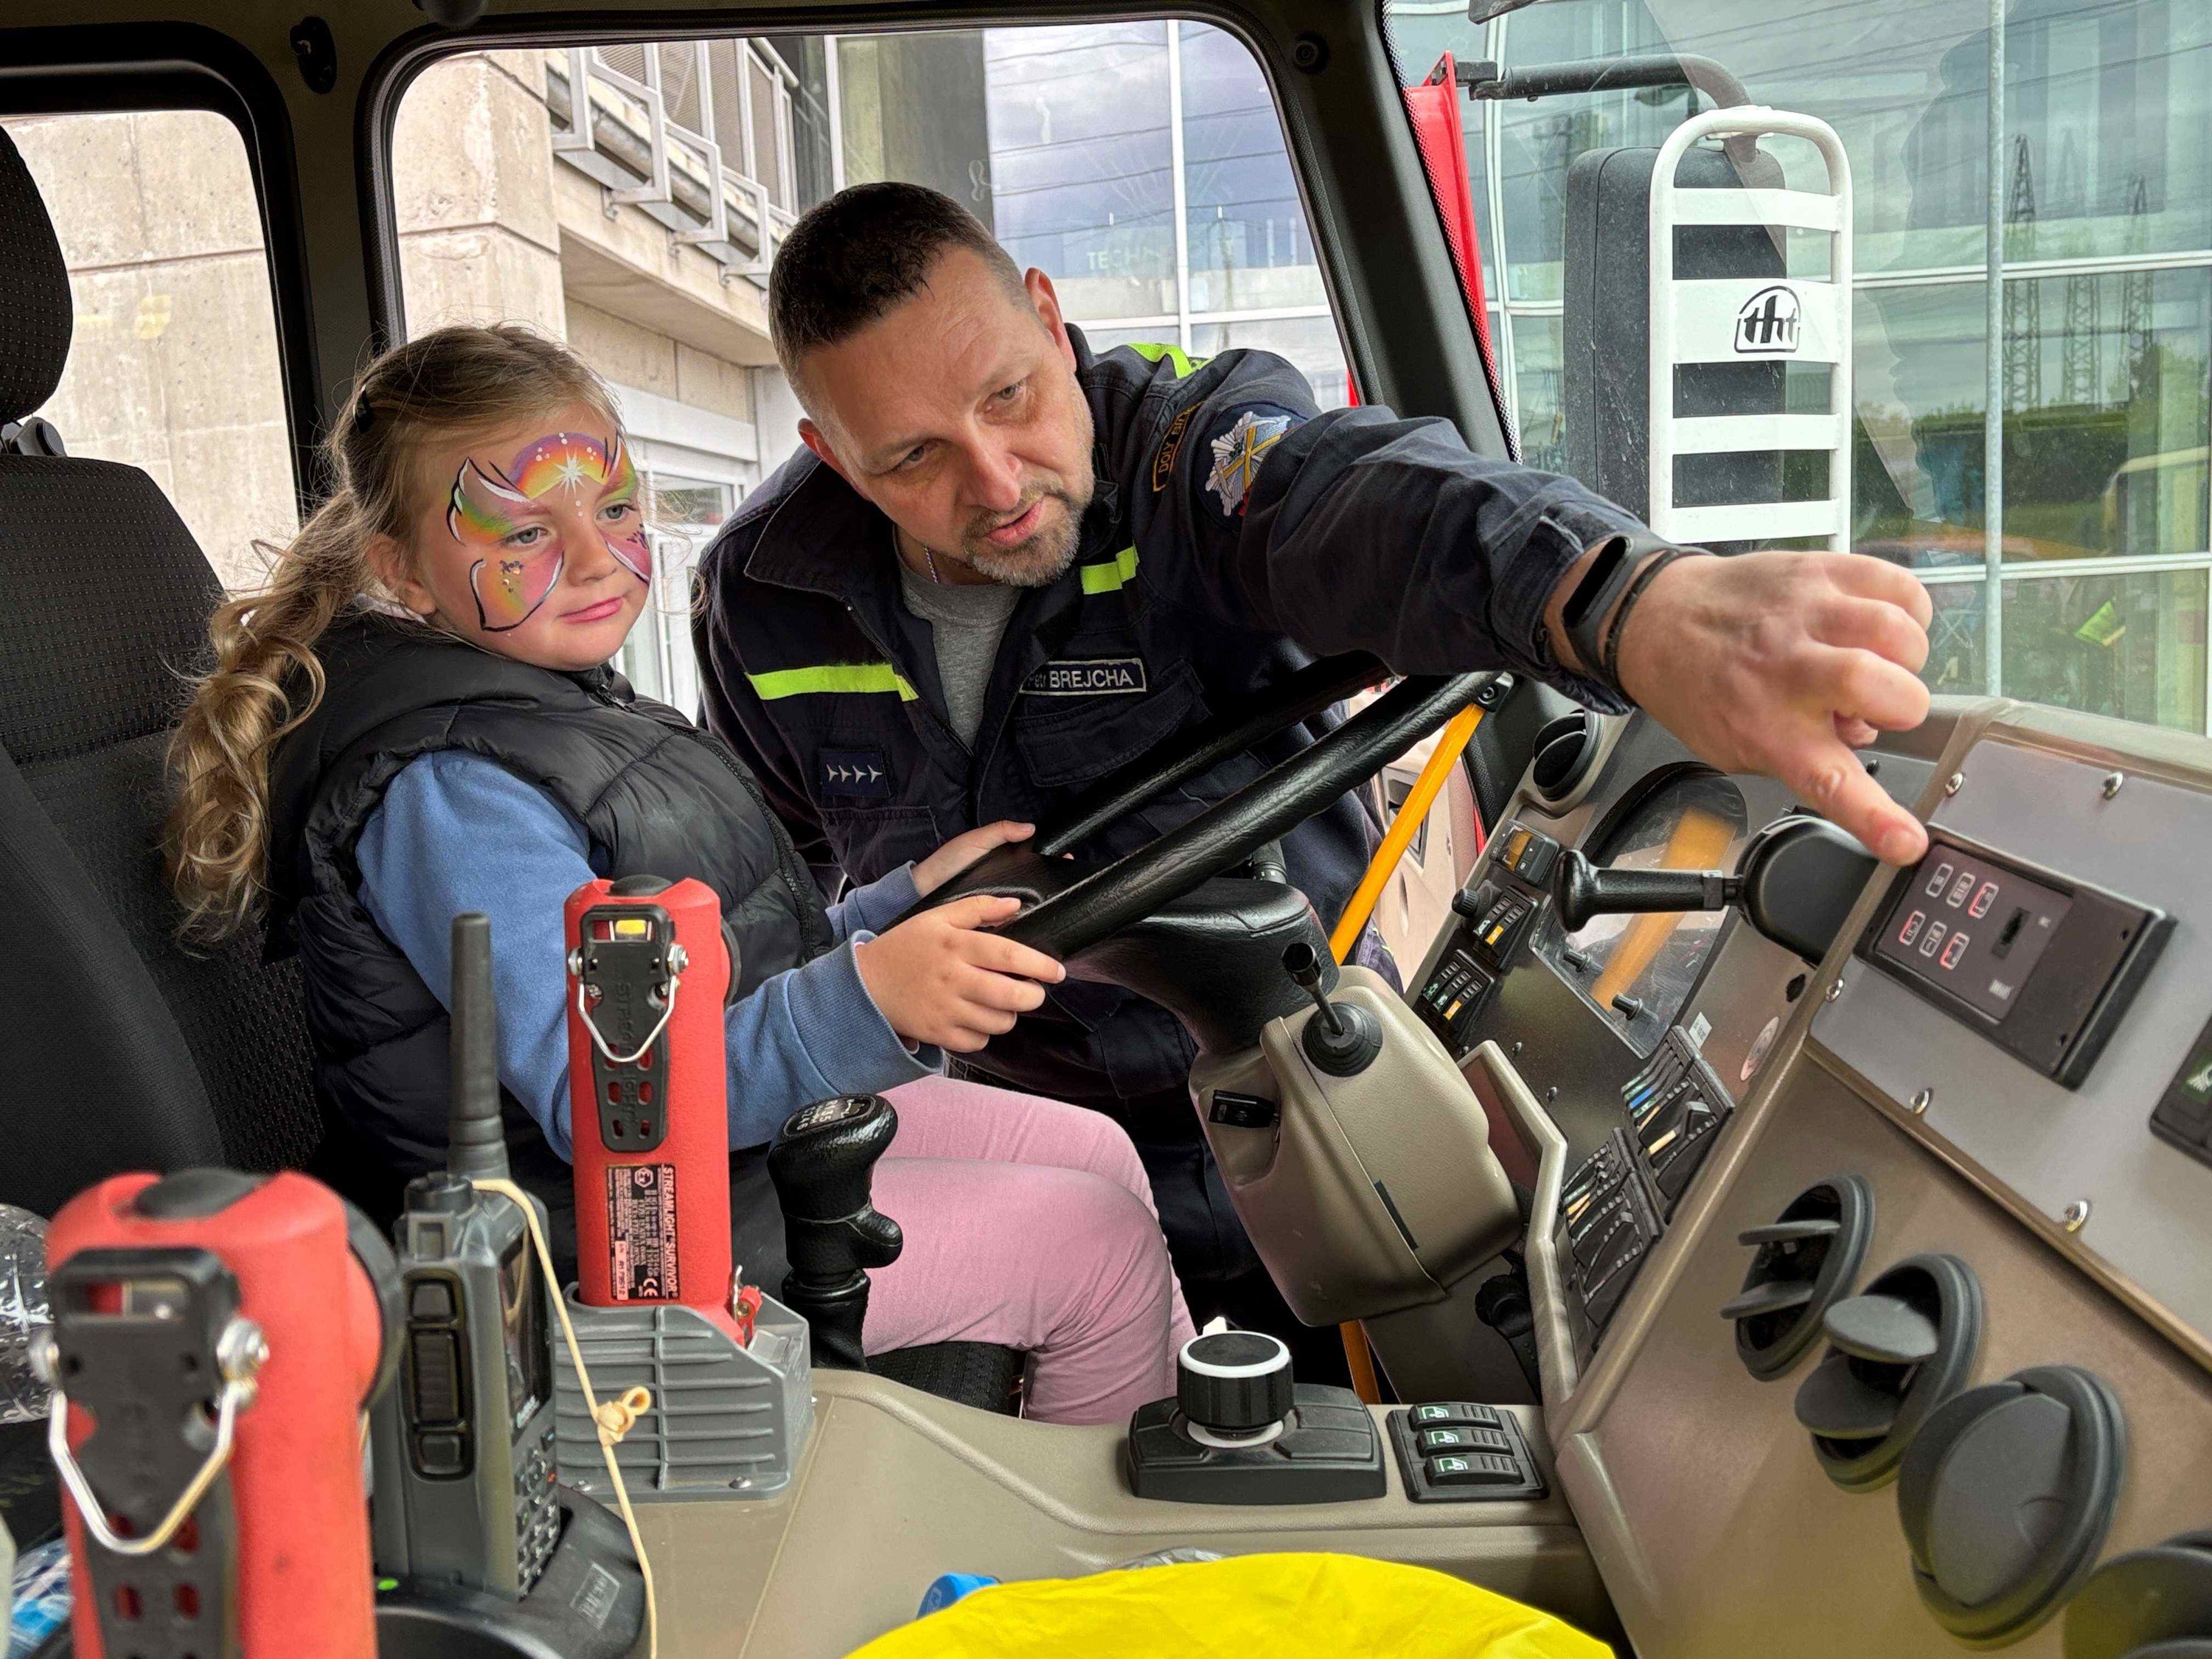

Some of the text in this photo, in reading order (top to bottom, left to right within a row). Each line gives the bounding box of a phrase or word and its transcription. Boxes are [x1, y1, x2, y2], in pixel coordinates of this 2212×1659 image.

[1158, 442, 1175, 473] DOLY
[1049, 669, 1135, 689] BREJCHA
[663, 1167, 678, 1293] STREAMLIGHT SURVIVOR
